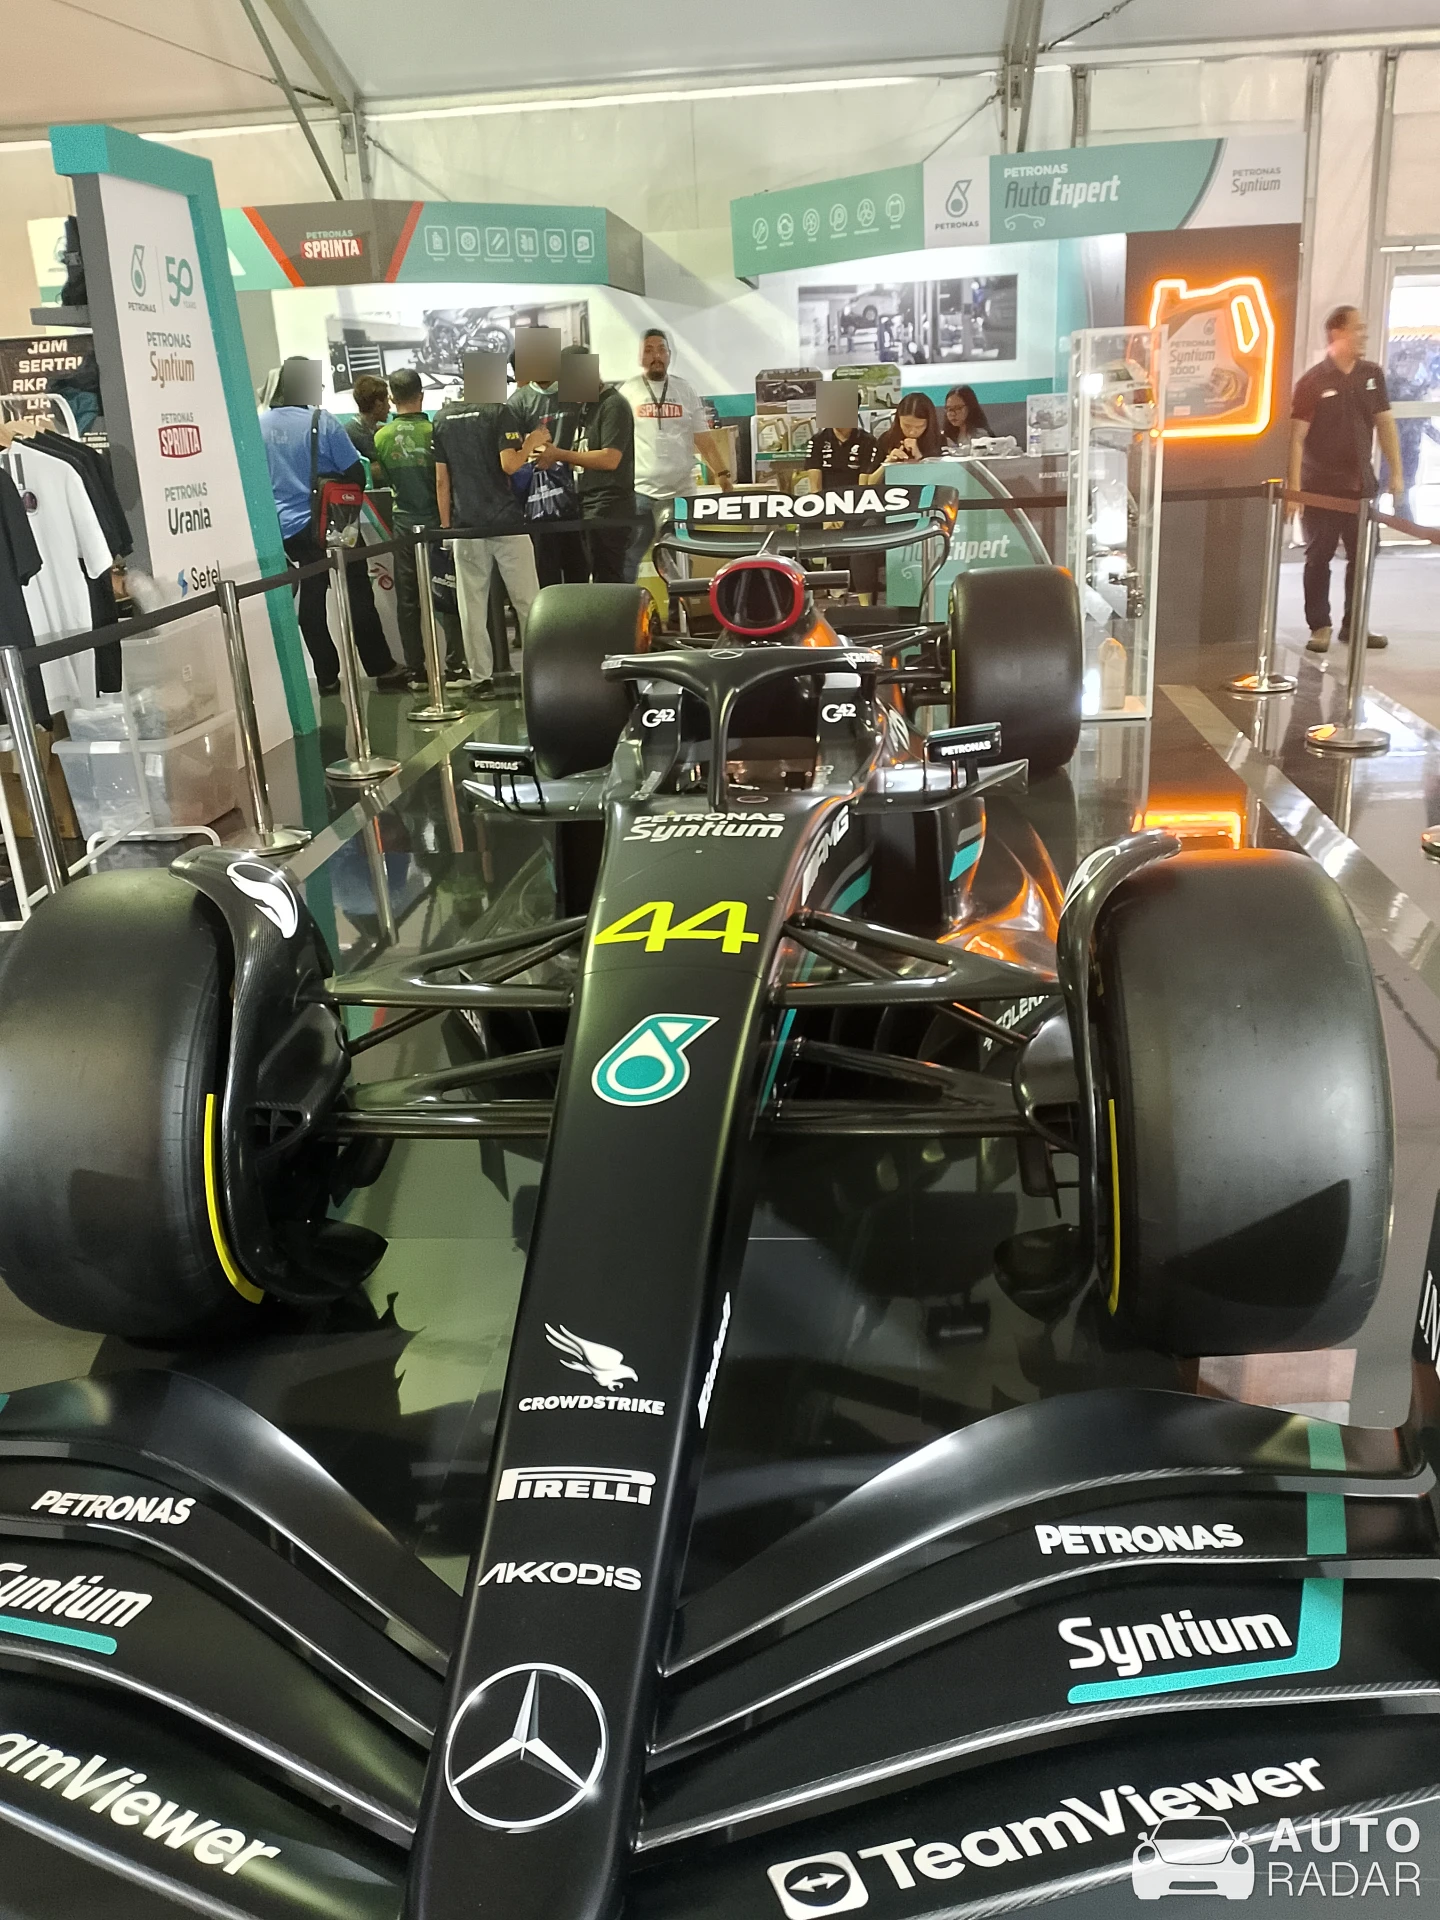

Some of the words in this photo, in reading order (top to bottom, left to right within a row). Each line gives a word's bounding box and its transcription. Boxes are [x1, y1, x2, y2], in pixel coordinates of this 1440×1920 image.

[1004, 164, 1068, 178] PETRONAS
[1233, 167, 1281, 177] PETRONAS
[1004, 175, 1121, 208] AutoExpert
[1231, 177, 1281, 196] Syntium
[306, 230, 353, 239] PETRONAS
[934, 220, 979, 231] PETRONAS
[303, 239, 360, 258] SPRINTA
[128, 301, 156, 313] PETRONAS
[27, 339, 68, 354] JOM
[147, 331, 192, 348] PETRONAS
[1169, 347, 1216, 364] Syntium
[150, 351, 195, 388] Syntium
[161, 412, 194, 424] PETRONAS
[639, 403, 681, 417] SPRNTA
[160, 427, 200, 456] SPRINTA
[164, 482, 208, 502] PETRONAS
[693, 487, 910, 520] PETRONAS
[168, 501, 212, 535] Urania
[191, 560, 221, 591] Setel
[642, 708, 675, 728] G42
[822, 703, 856, 723] G42
[941, 740, 991, 756] PETRONAS
[474, 760, 519, 771] PETRONAS
[633, 812, 786, 825] PETRONAS
[623, 821, 784, 842] Syntium
[594, 901, 759, 953] 44
[518, 1395, 665, 1415] CROWDSTRIKE
[497, 1466, 656, 1505] PIRELLI
[31, 1490, 196, 1525] PETRONAS
[1035, 1523, 1244, 1555] PETRONAS
[1058, 1609, 1293, 1677] Syntium
[857, 1756, 1325, 1891] TeamViewer
